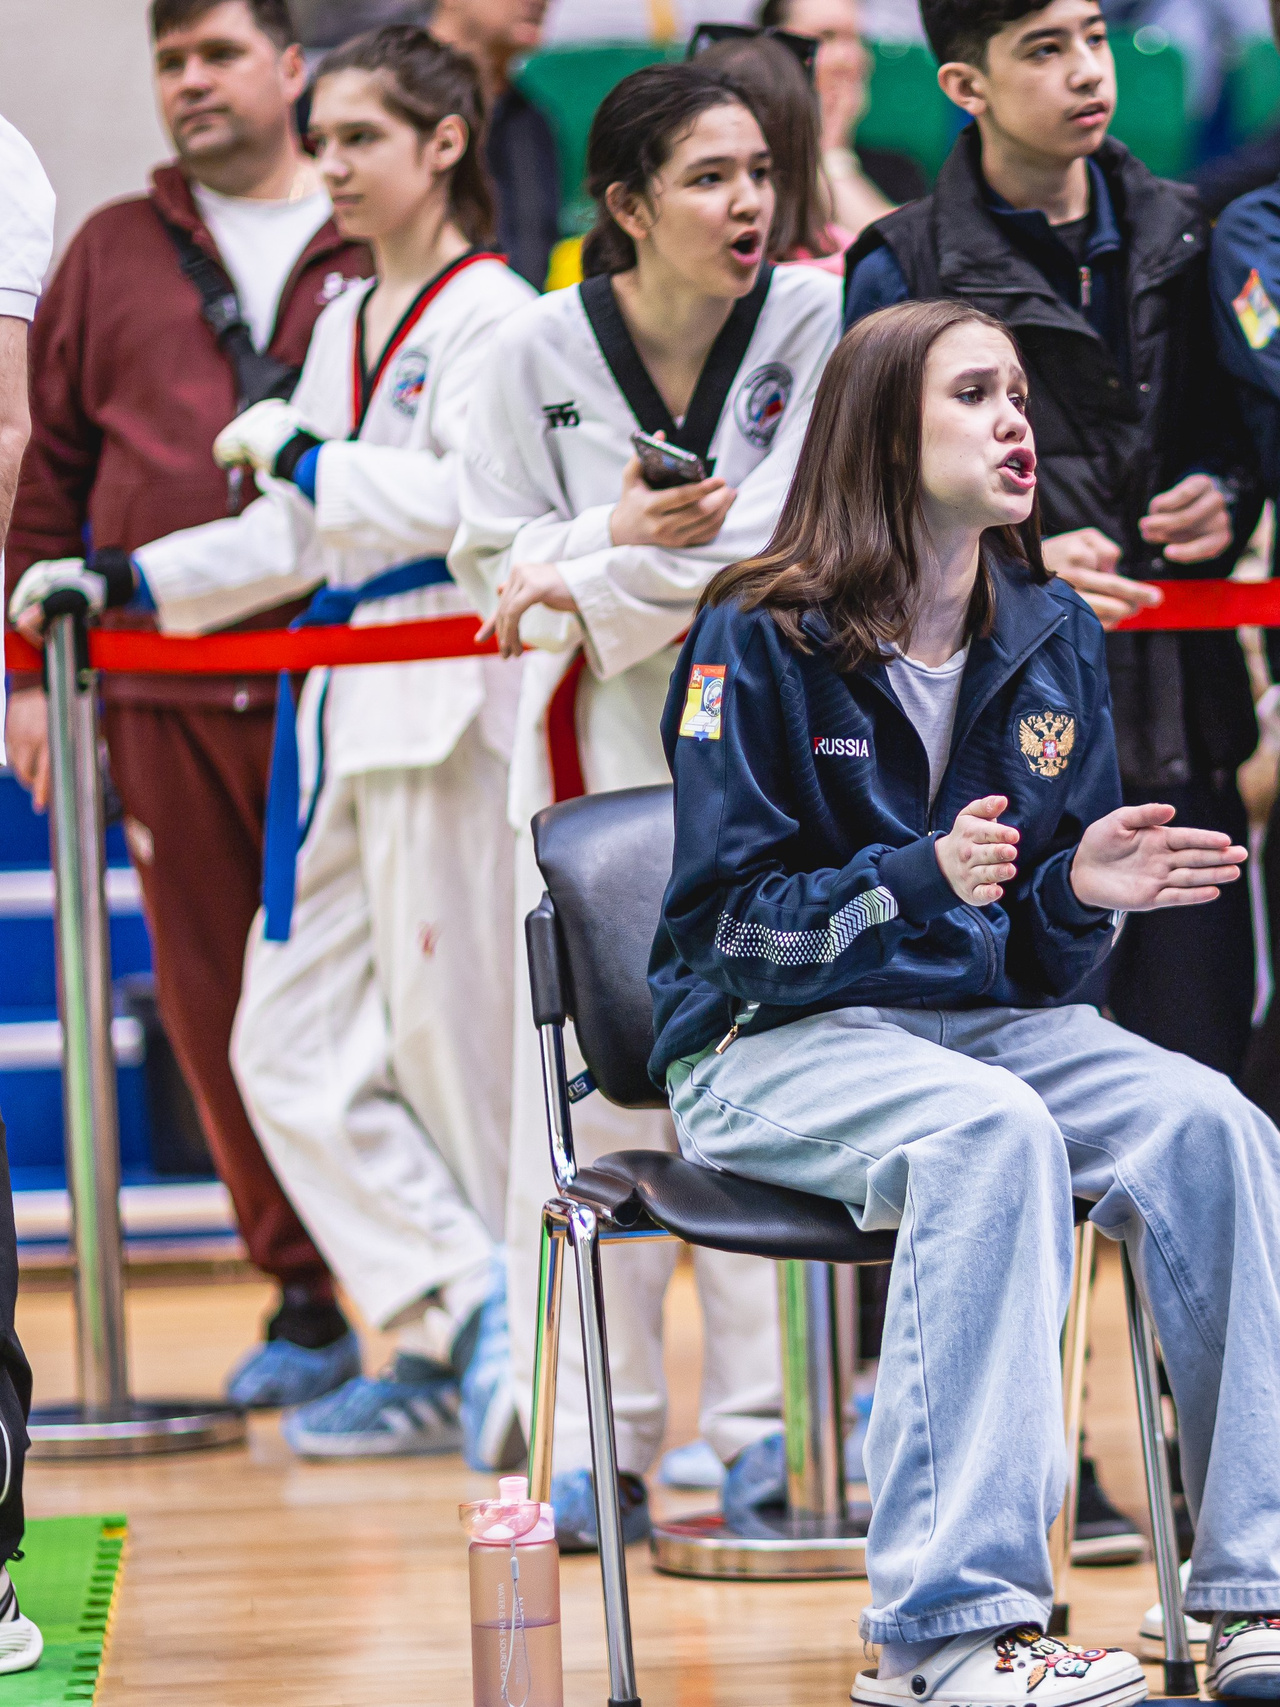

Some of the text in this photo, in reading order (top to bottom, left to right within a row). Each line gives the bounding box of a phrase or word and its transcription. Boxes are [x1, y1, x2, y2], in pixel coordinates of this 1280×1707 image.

[813, 737, 869, 757] RUSSIA
[497, 1582, 506, 1610] WATER
[499, 1621, 507, 1635] THE
[499, 1638, 508, 1669] SOURCE
